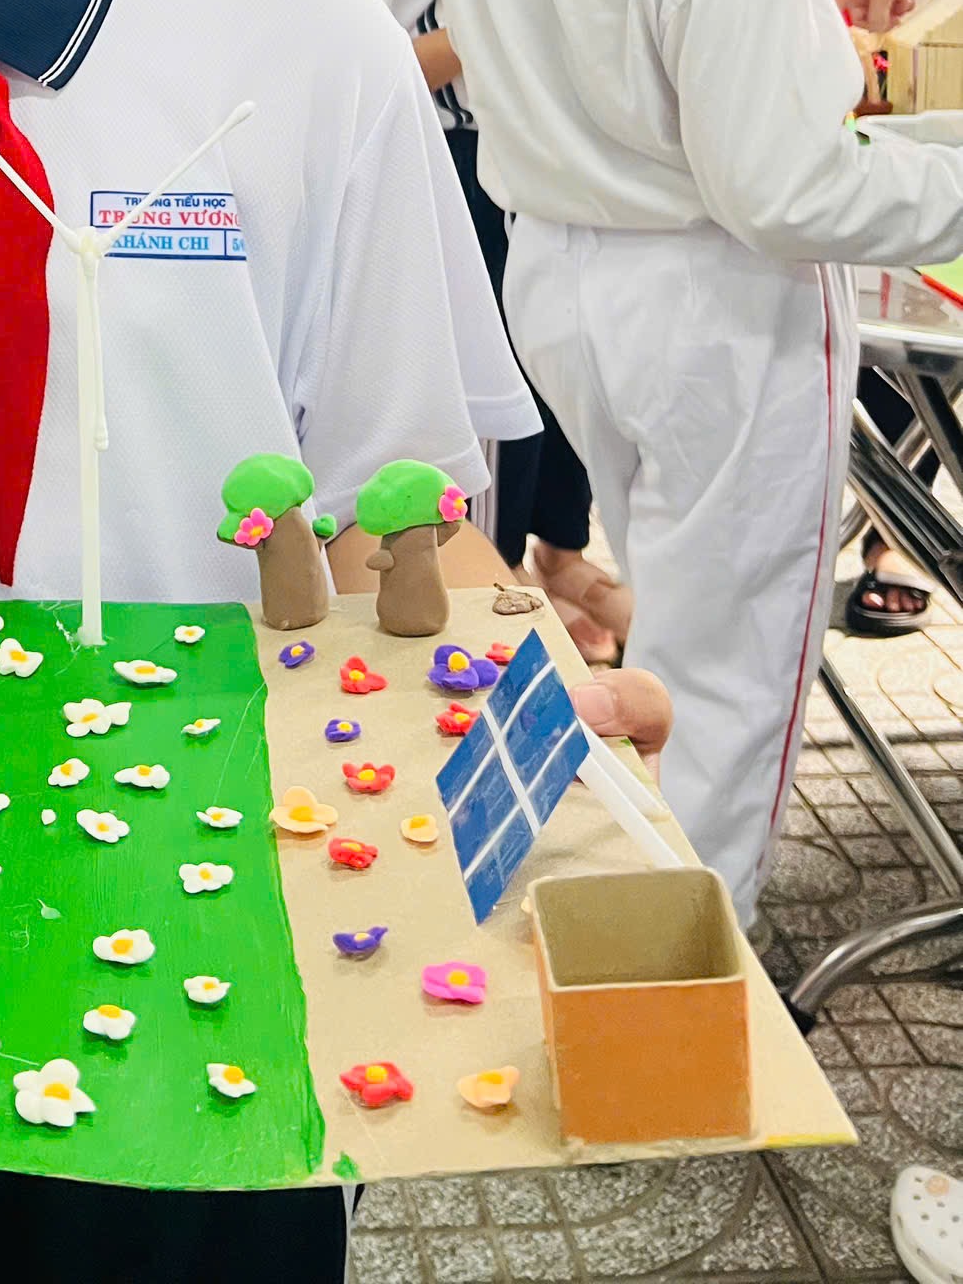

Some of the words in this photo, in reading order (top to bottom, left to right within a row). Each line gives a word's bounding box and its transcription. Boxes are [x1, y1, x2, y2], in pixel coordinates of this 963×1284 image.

[174, 194, 200, 208] TIỂU
[203, 198, 226, 209] HỌC
[178, 236, 210, 251] CHI
